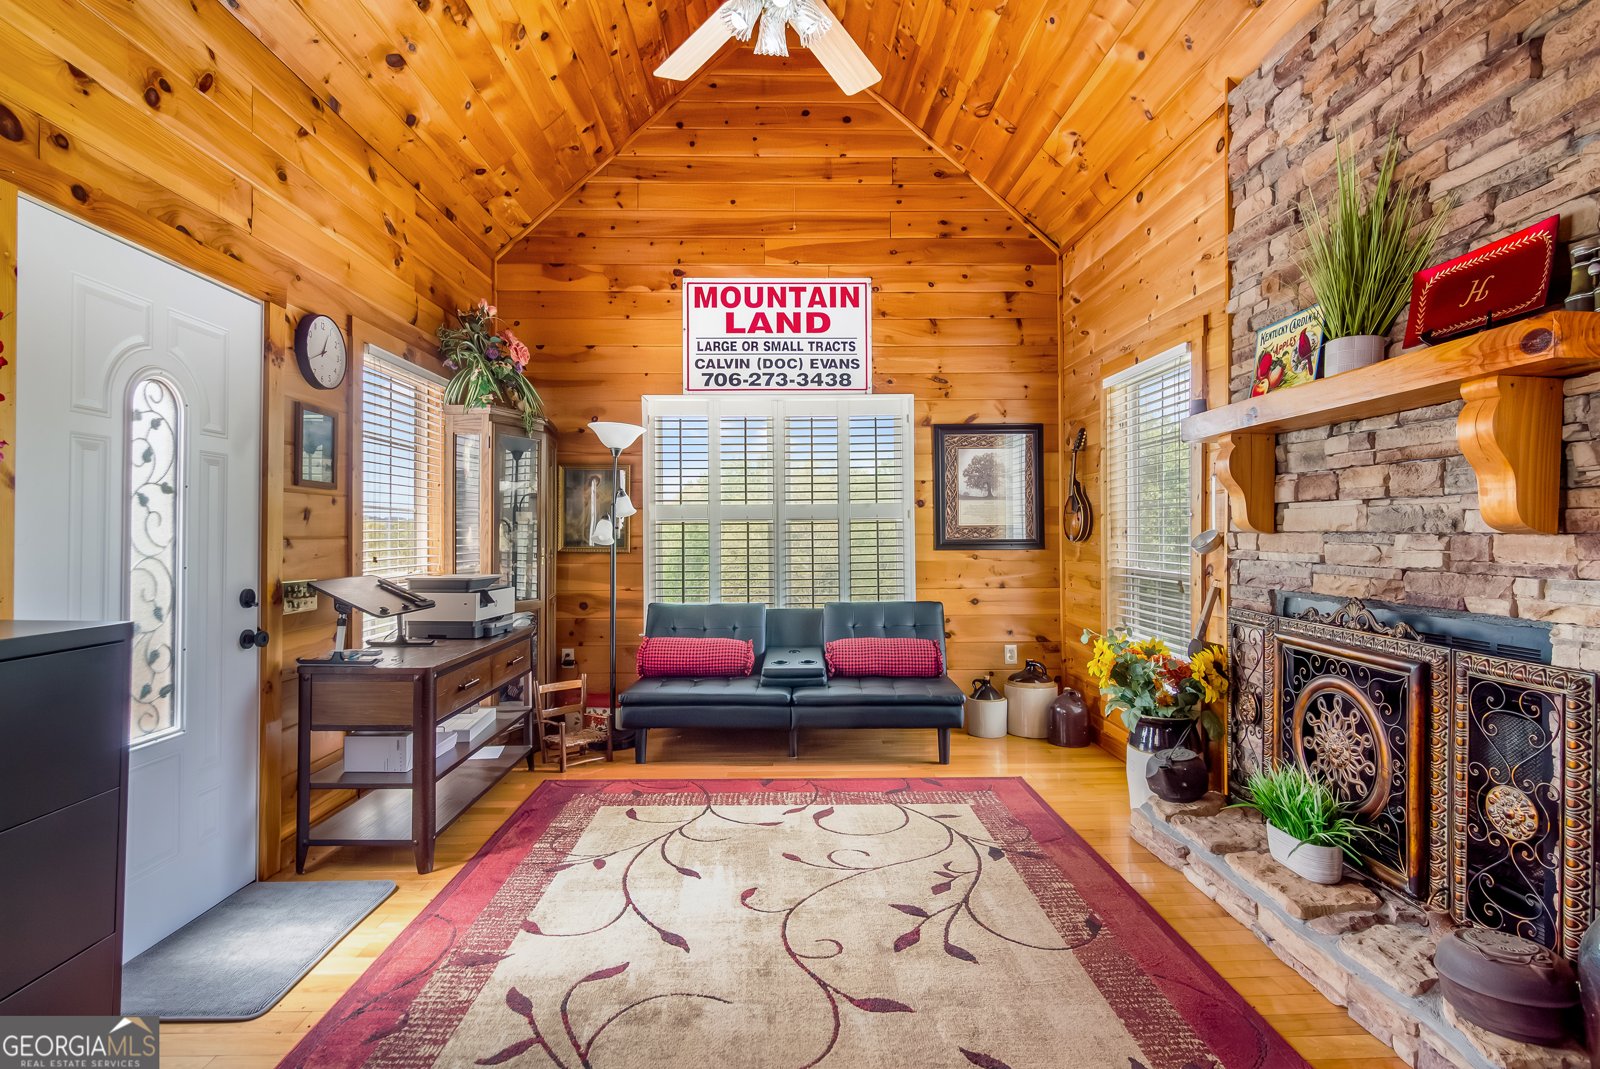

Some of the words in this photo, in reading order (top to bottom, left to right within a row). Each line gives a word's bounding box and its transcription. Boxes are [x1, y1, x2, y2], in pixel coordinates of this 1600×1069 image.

[694, 286, 860, 308] MOUNTAIN
[1458, 274, 1495, 308] H
[725, 312, 831, 334] LAND
[1260, 323, 1290, 346] KENTUCKY
[1273, 335, 1297, 355] APPLES
[697, 341, 737, 352] LARGE
[742, 341, 759, 352] OR
[763, 341, 804, 352] SMALL
[808, 341, 856, 352] TRACTS
[695, 358, 750, 370] CALVIN
[757, 357, 803, 371] (DOC)
[810, 358, 860, 370] EVANS
[702, 373, 852, 387] 706-273-3438
